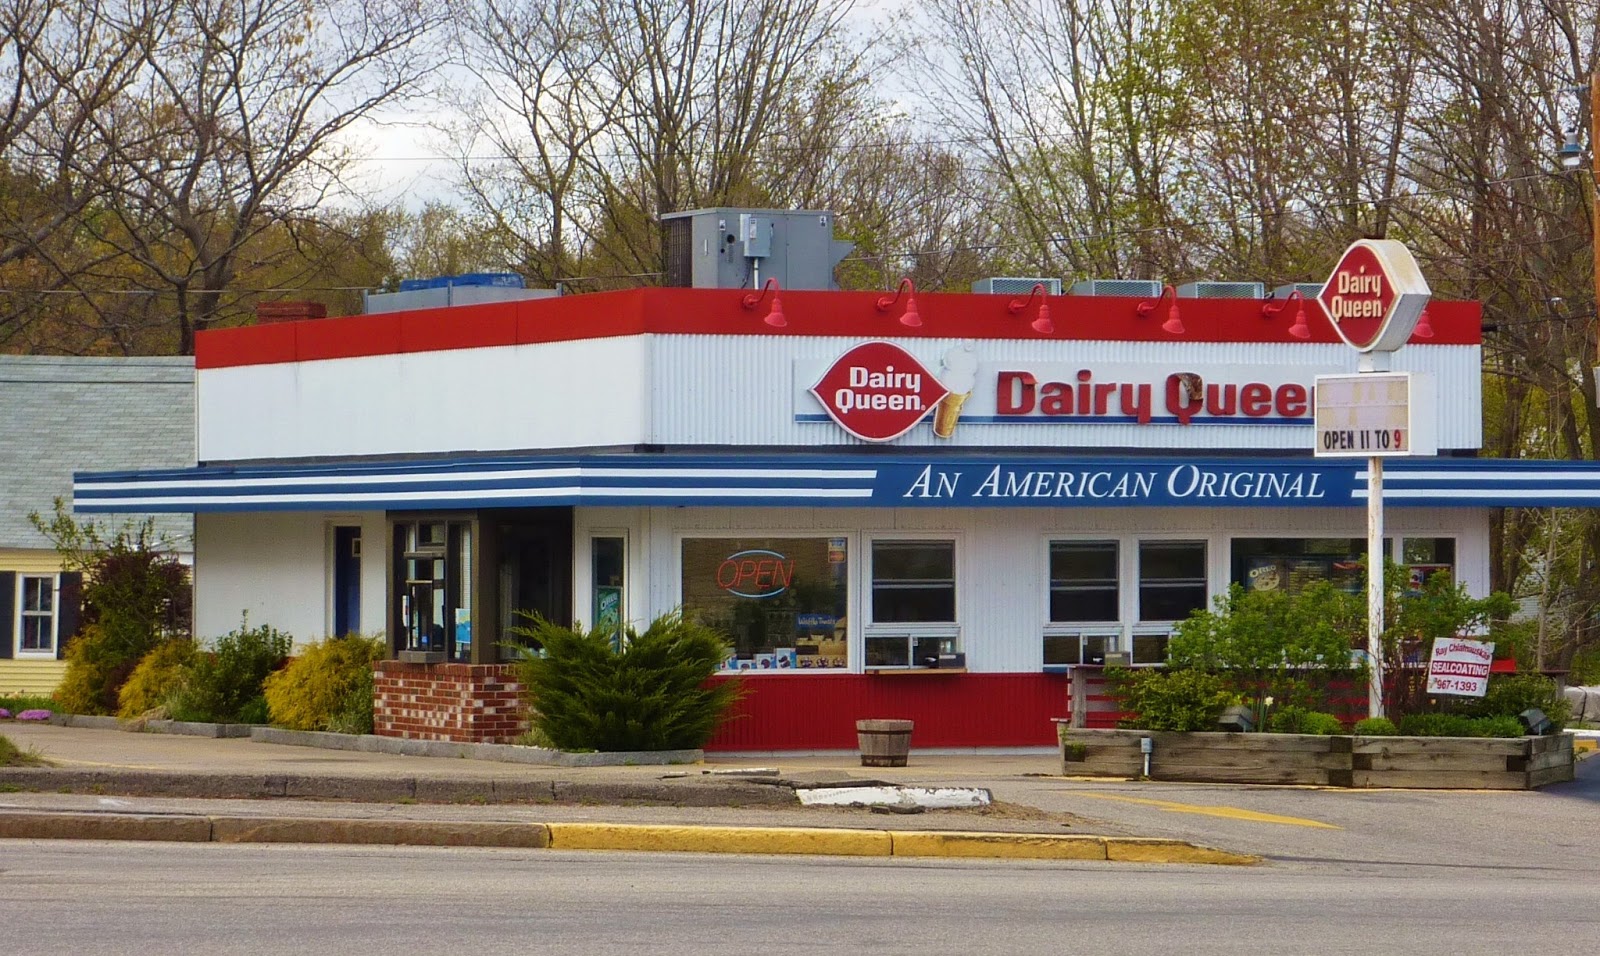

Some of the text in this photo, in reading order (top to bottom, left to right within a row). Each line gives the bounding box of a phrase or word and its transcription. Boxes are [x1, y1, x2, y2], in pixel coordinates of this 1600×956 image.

[1338, 265, 1382, 298] Dairy
[1331, 295, 1383, 322] Queen
[849, 365, 921, 393] Dairy
[835, 388, 922, 414] Queen
[996, 369, 1315, 425] Dairy Quee
[1323, 430, 1354, 450] OPEN
[1375, 429, 1389, 449] TO
[1394, 429, 1402, 449] 9
[902, 464, 1326, 498] AN AMERICAN ORIGINAL
[717, 559, 796, 588] OPEN
[1432, 662, 1488, 676] SEALCOATING
[1436, 680, 1477, 692] 967-1393
